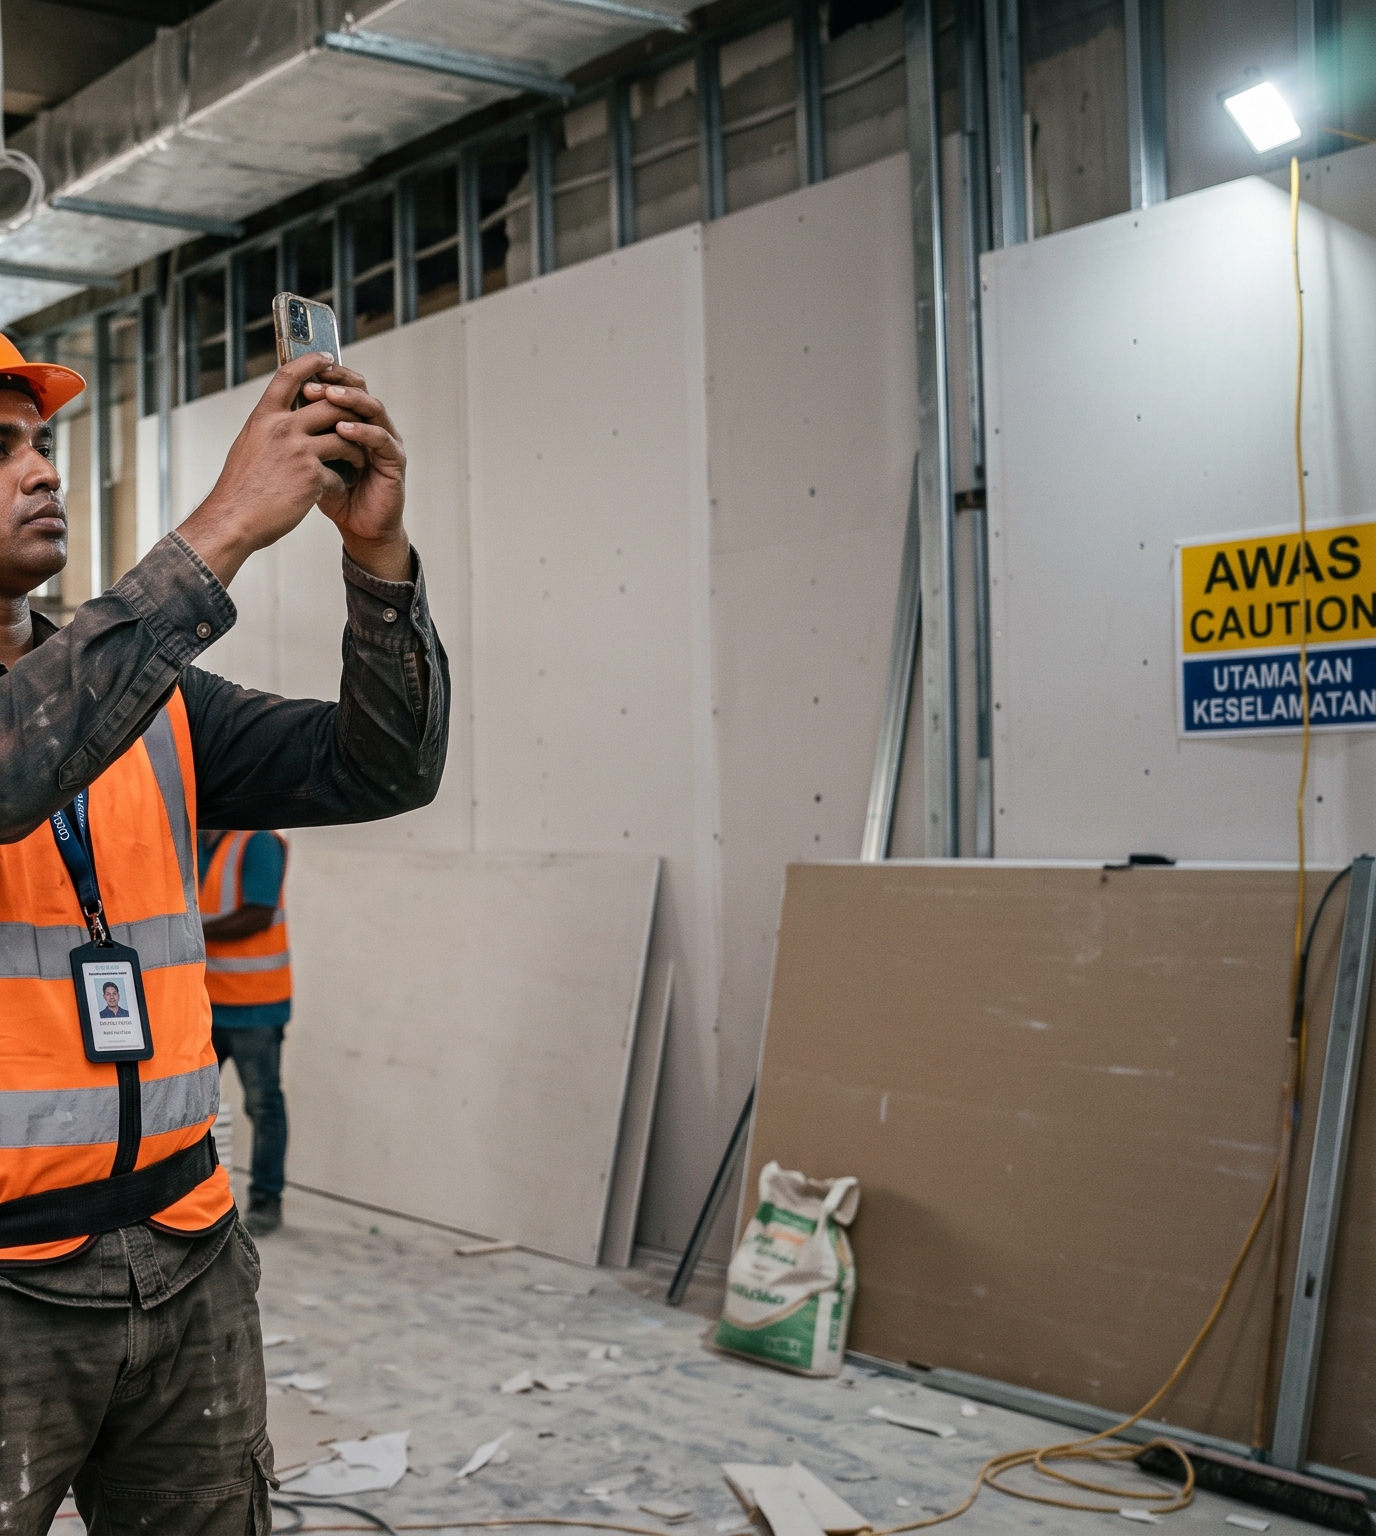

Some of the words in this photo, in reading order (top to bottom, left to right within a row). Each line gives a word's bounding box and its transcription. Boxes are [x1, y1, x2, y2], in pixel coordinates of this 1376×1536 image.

[1204, 535, 1362, 595] AWAS
[1190, 592, 1376, 643] CAUTION
[1213, 656, 1354, 692] UTAMAKAN
[1192, 688, 1376, 725] KESELAMATAN
